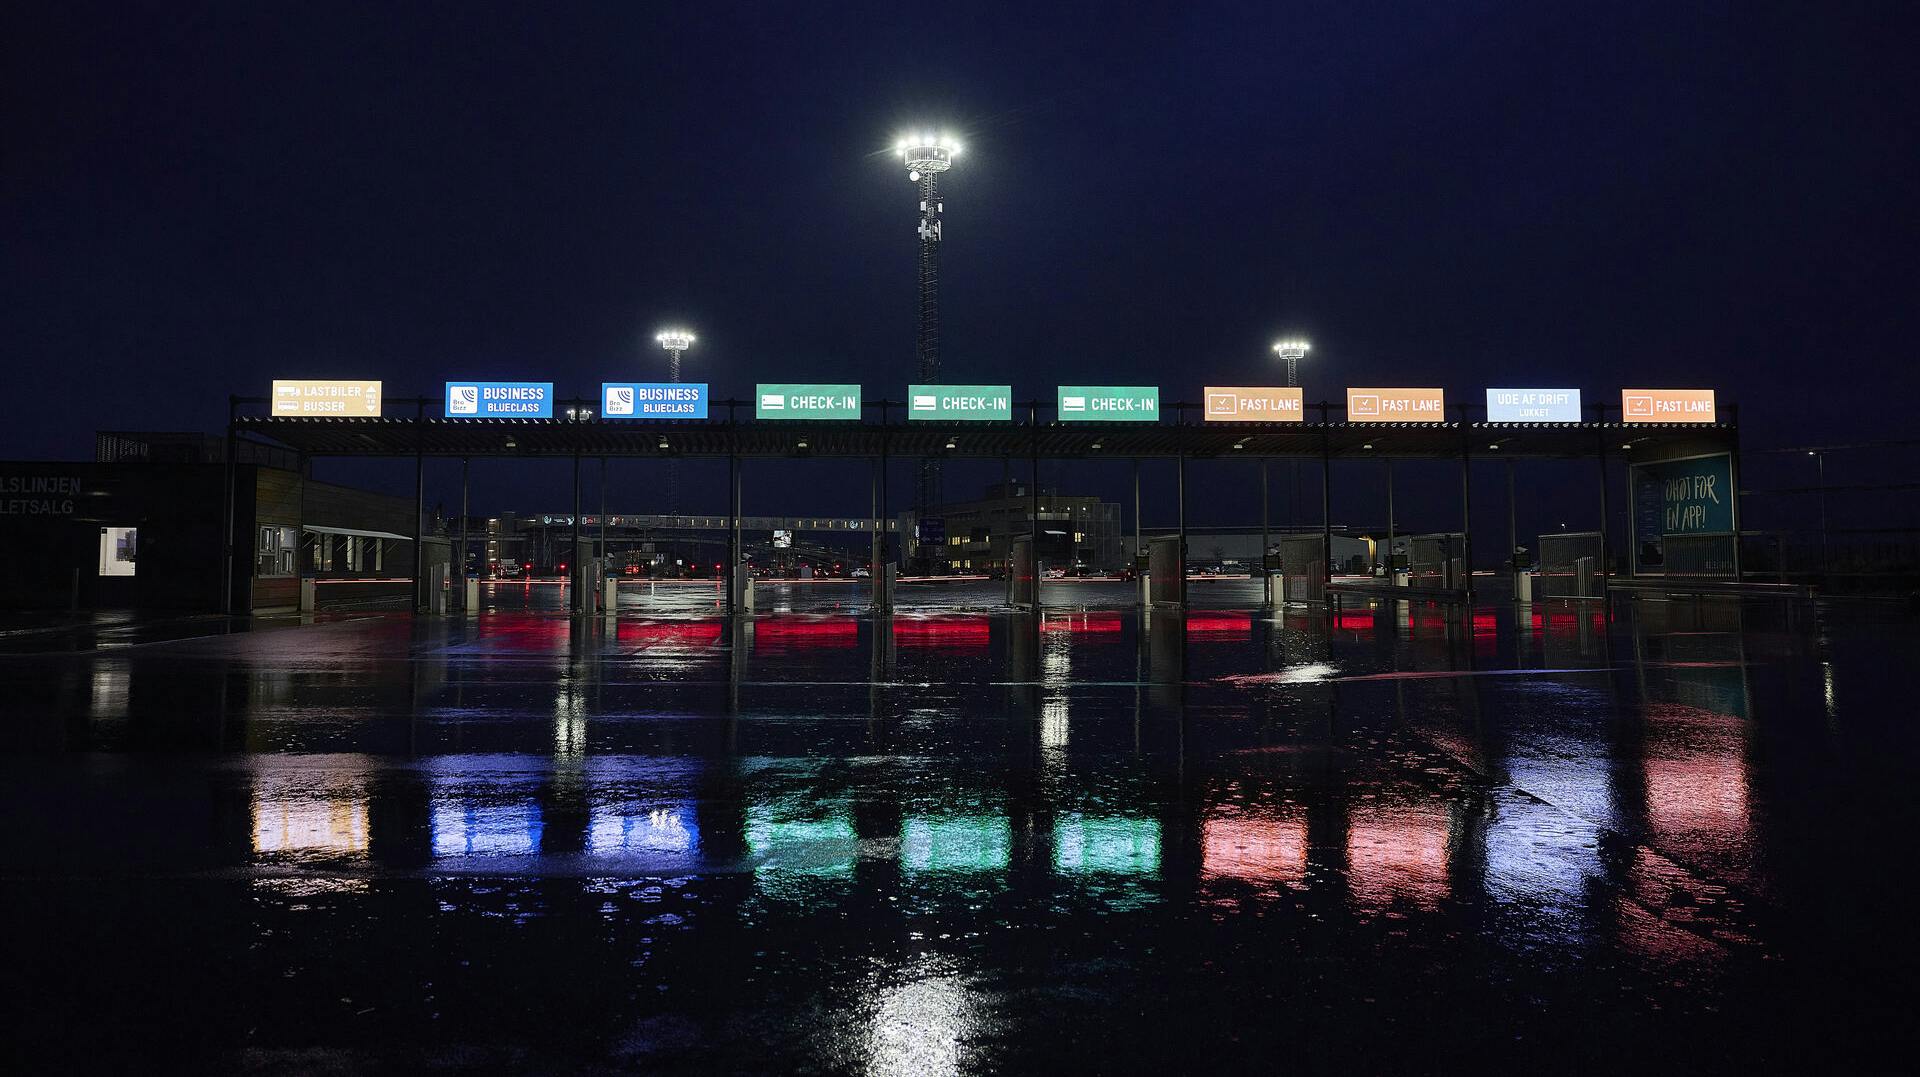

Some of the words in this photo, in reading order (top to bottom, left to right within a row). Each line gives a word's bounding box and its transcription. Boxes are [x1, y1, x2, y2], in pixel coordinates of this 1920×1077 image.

[303, 386, 361, 397] LASTBILER
[483, 387, 544, 400] BUSINESS
[639, 388, 699, 401] BUSINESS
[790, 396, 856, 409] CHECK-IN
[942, 397, 1007, 410] CHECK-IN
[1091, 398, 1154, 411] CHECK-IN
[1240, 399, 1268, 411] FAST
[1270, 399, 1299, 411] LANE
[1382, 399, 1410, 411] FAST
[1412, 399, 1440, 411] LANE
[1497, 393, 1519, 405] UDE
[1522, 393, 1537, 405] AF
[1540, 393, 1569, 405] DRIFT
[303, 401, 345, 412] BUSSER
[487, 403, 540, 412] BLUECLASS
[643, 403, 695, 413] BLUECLASS
[1656, 400, 1682, 412] FAST
[1684, 400, 1712, 412] LANE
[1520, 408, 1549, 417] LUKKET
[0, 476, 80, 493] LSLINJEN
[1694, 474, 1720, 504] FOR
[0, 500, 74, 514] LETSALG
[1666, 503, 1680, 531] EN
[1681, 504, 1706, 532] APP!
